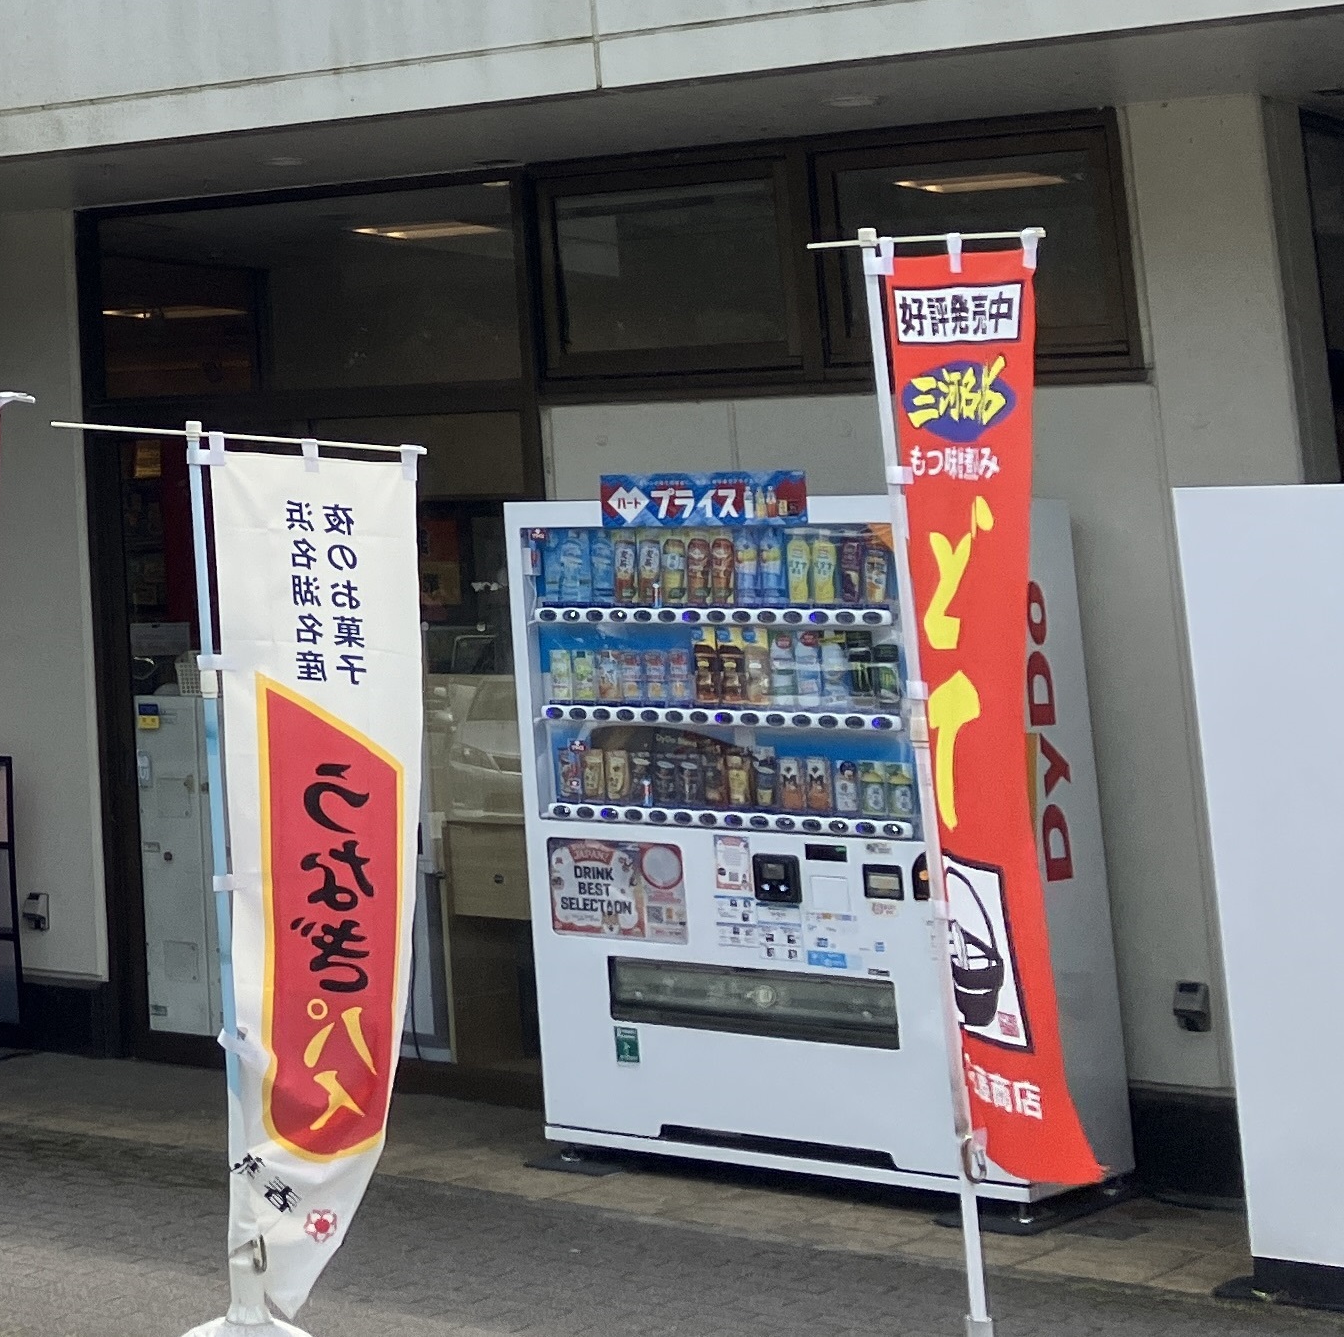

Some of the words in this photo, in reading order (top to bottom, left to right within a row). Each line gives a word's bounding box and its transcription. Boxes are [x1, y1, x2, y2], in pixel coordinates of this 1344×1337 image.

[899, 291, 1015, 337] 好評発売中
[617, 496, 642, 510] ハート
[650, 487, 740, 519] プライス
[573, 865, 614, 881] DRINK
[578, 882, 610, 897] BEST
